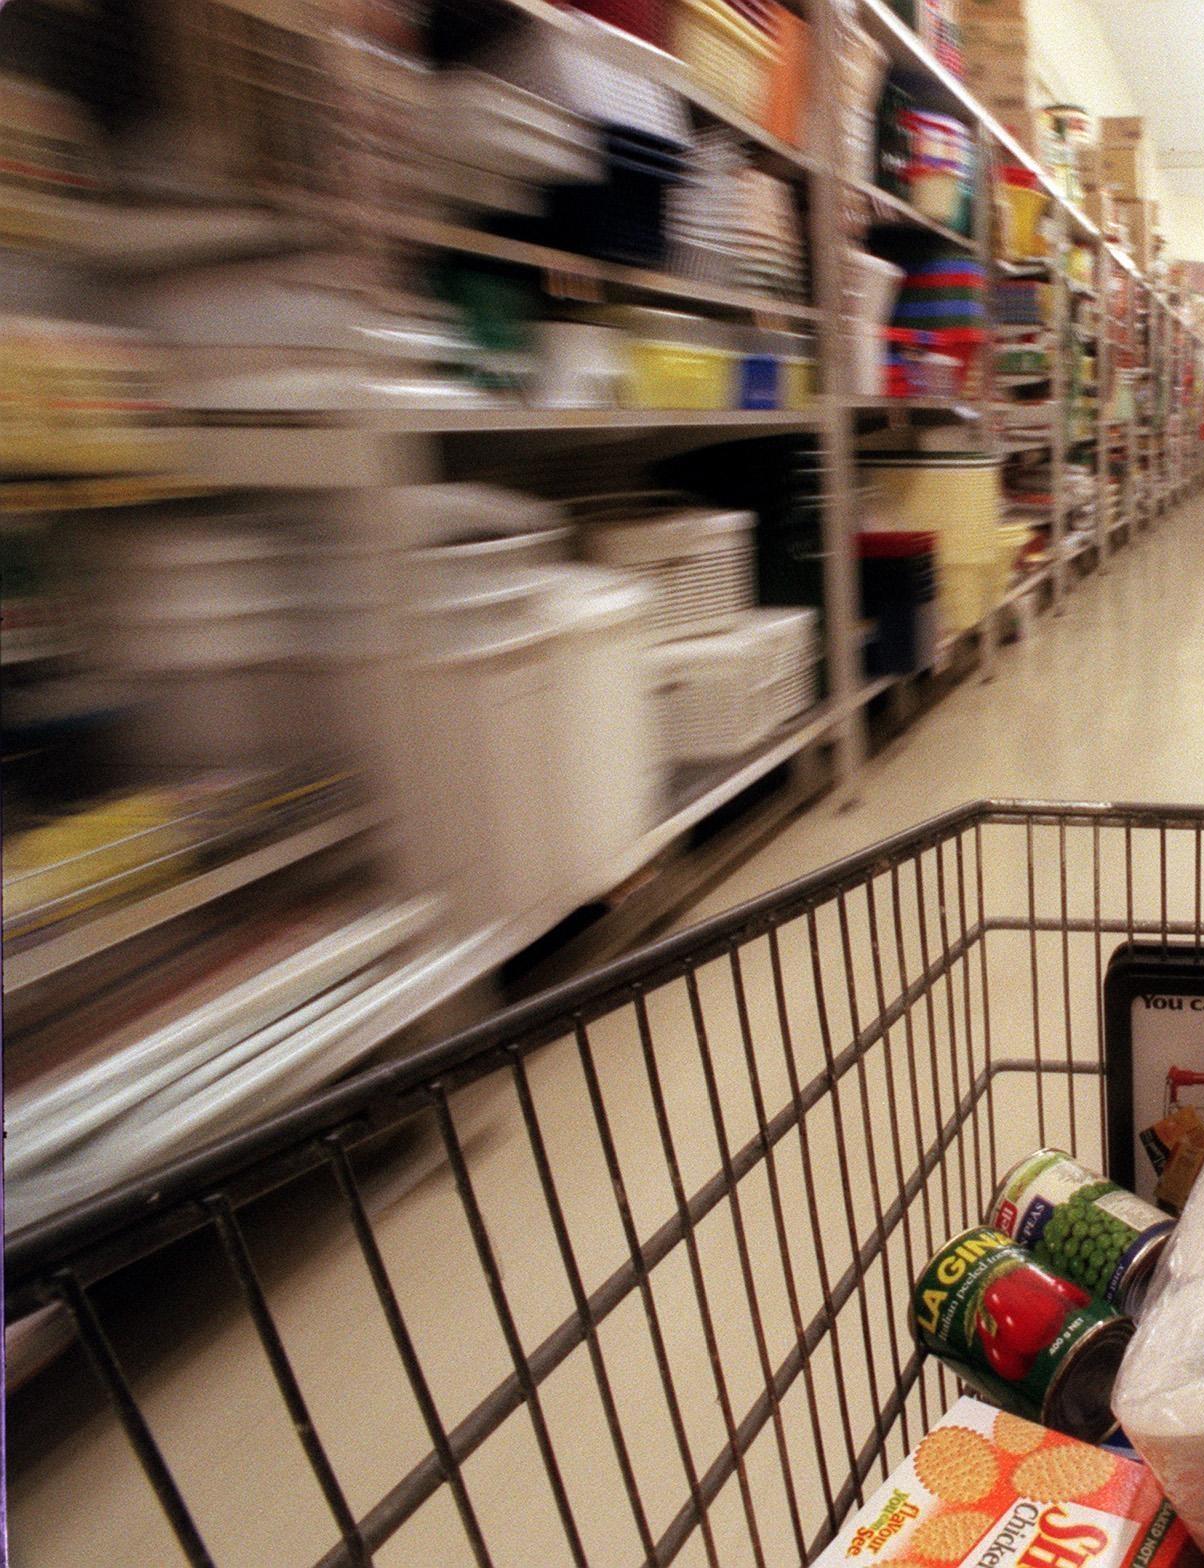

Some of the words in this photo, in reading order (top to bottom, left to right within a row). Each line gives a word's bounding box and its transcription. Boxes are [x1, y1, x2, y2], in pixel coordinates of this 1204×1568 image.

[1140, 994, 1184, 1011] You
[1024, 1202, 1046, 1236] PEAS
[956, 1260, 988, 1300] peeled
[918, 1289, 948, 1334] LA
[1017, 1505, 1109, 1568] SH
